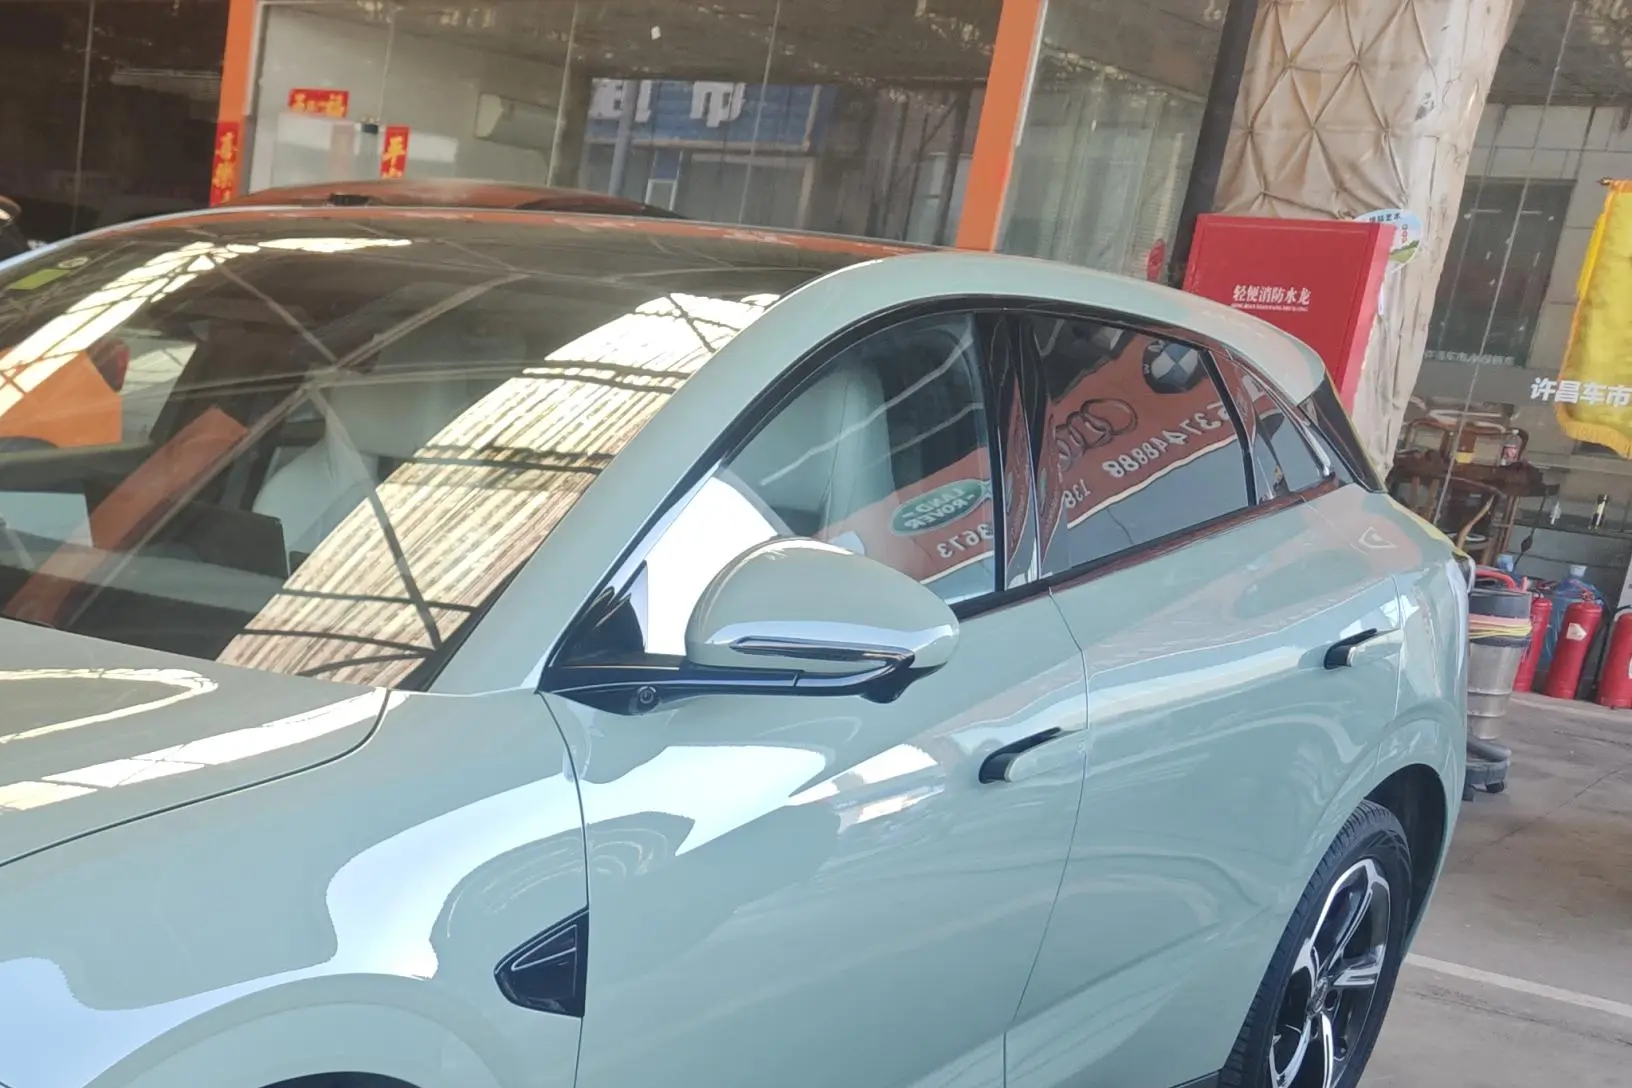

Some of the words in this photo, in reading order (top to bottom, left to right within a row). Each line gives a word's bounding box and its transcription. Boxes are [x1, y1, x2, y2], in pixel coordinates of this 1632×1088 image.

[1232, 284, 1312, 306] 轻便消防水龙
[1530, 376, 1632, 408] 许昌车市
